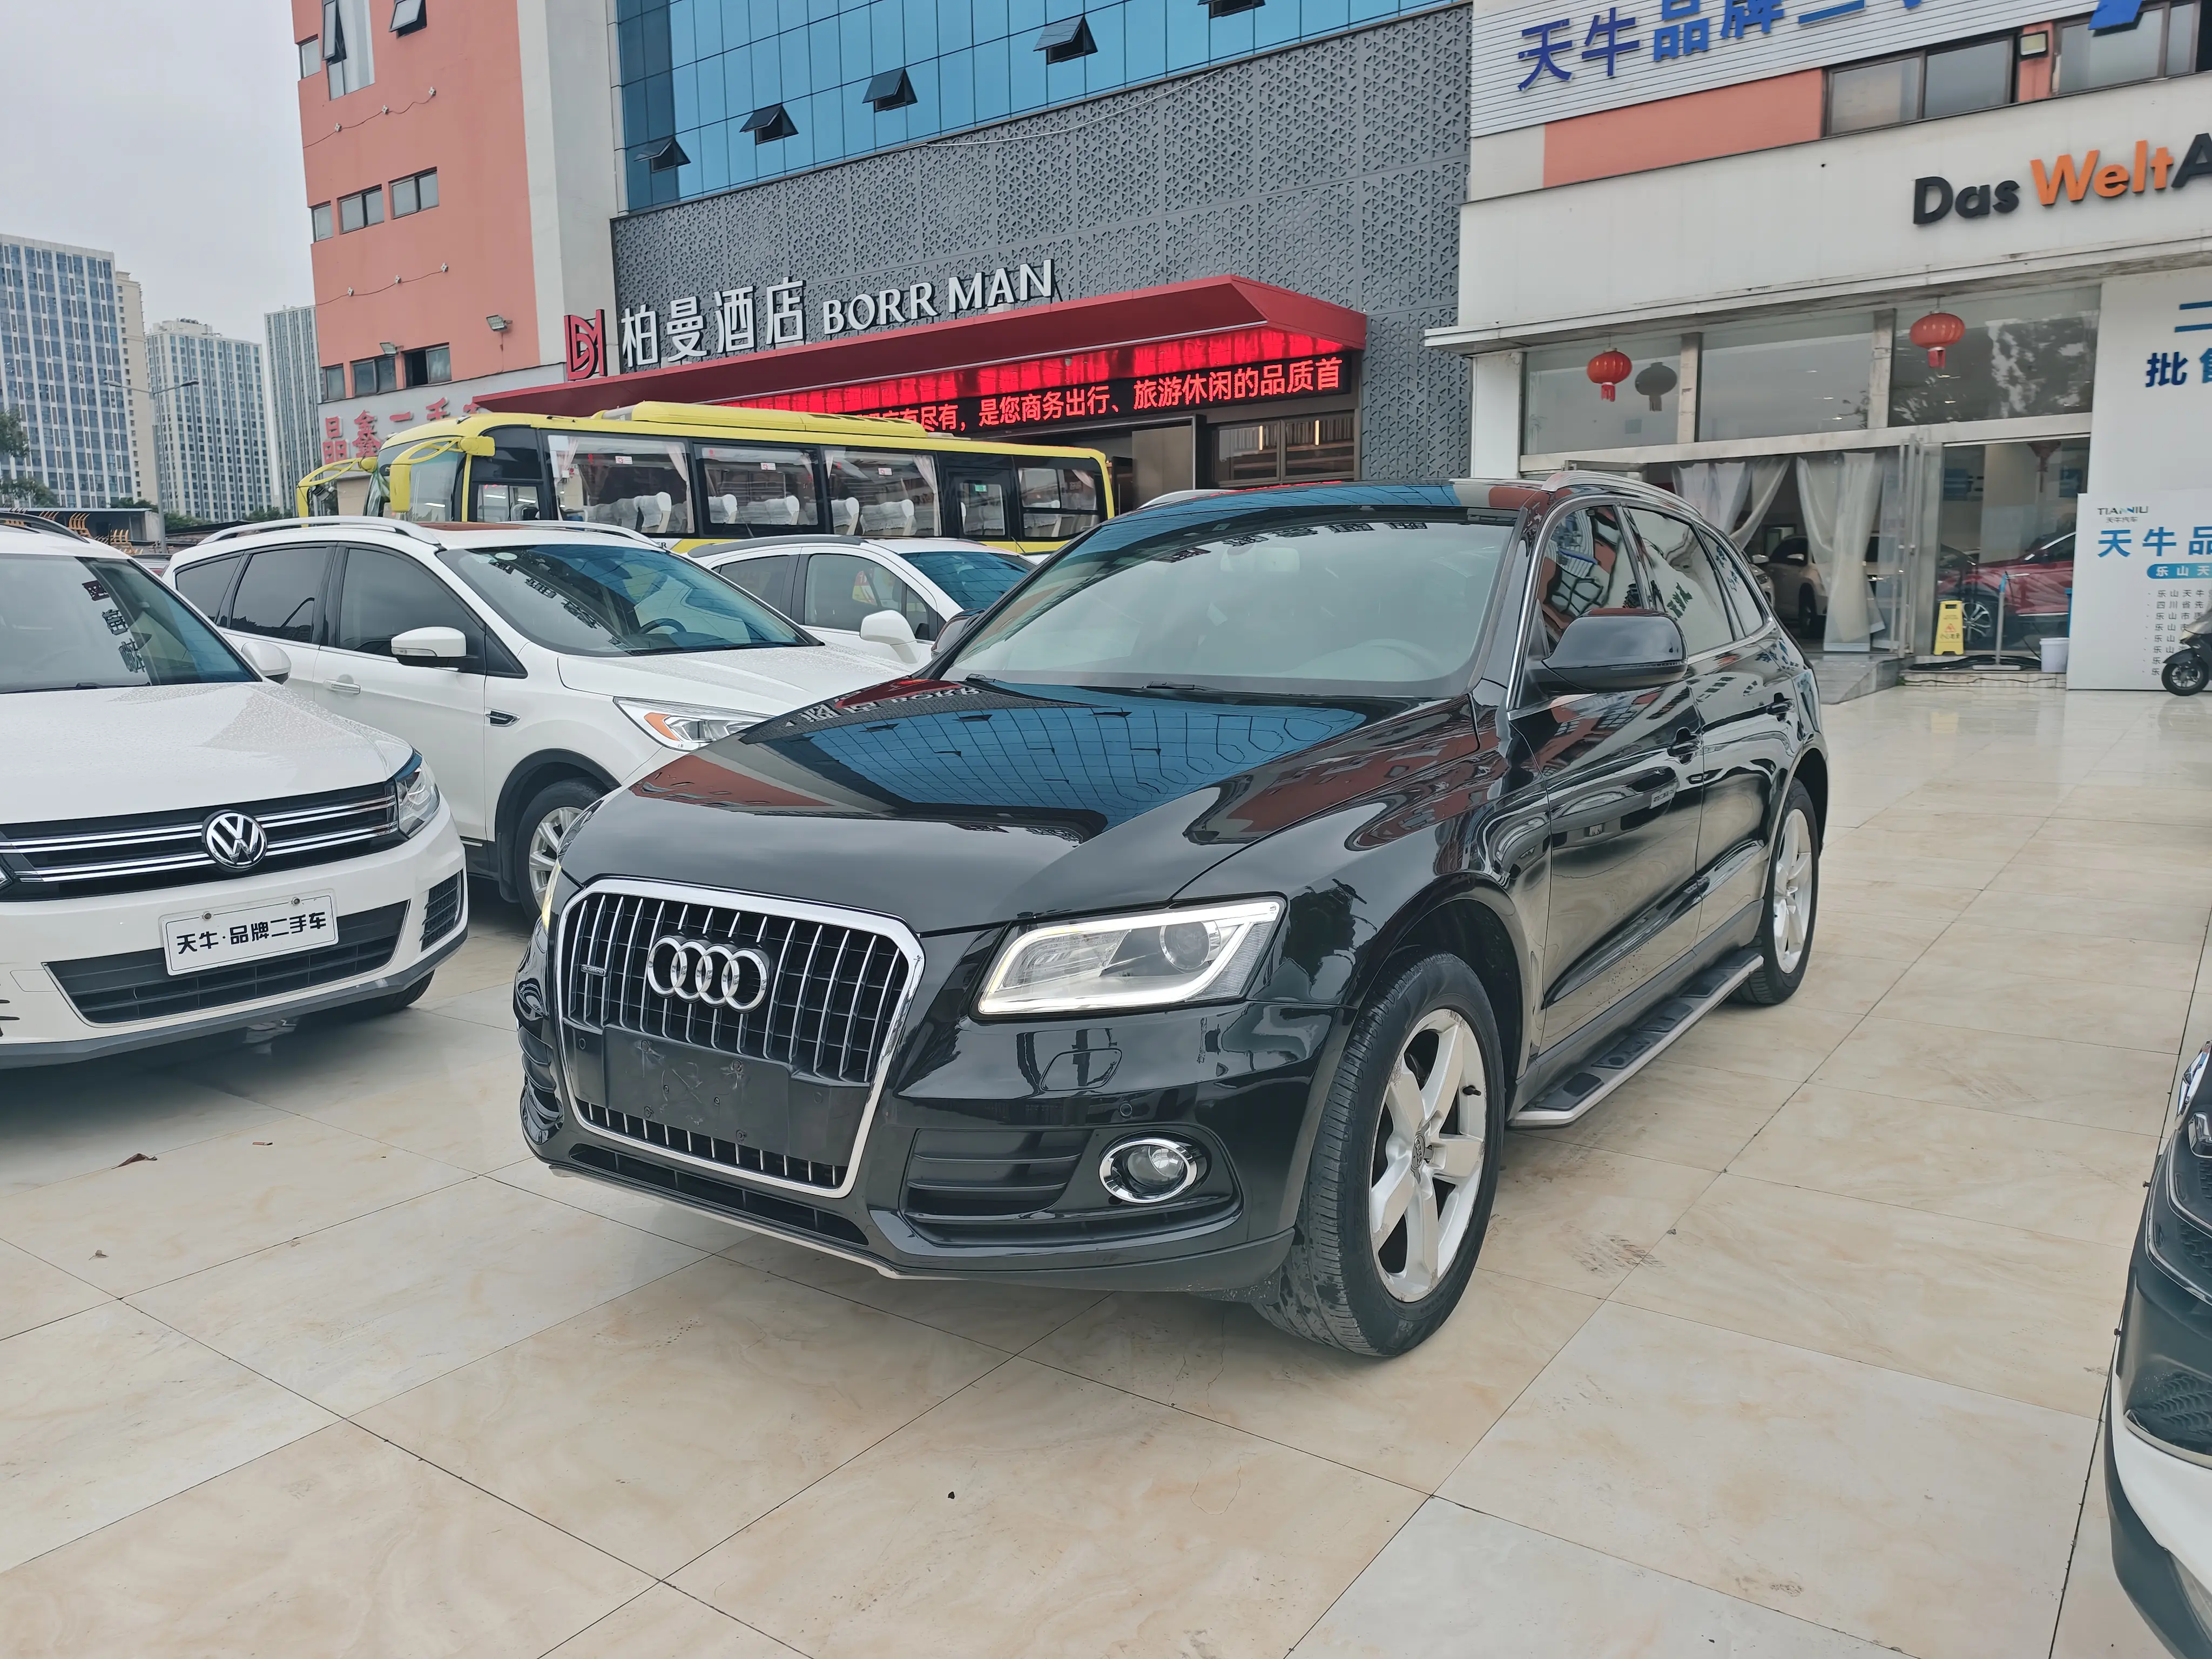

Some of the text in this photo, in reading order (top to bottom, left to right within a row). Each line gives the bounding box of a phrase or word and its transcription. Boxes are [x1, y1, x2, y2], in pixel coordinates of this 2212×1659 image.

[1518, 0, 1921, 92] 天牛品牌
[1913, 176, 2020, 224] Das
[622, 276, 806, 367] 柏曼酒店
[823, 259, 1054, 335] BORR MAN
[856, 356, 1343, 431] 有尽有，是您商务出行、旅游休闲的品质首
[2156, 565, 2210, 576] 乐山天
[2154, 635, 2175, 643] 乐山
[207, 811, 267, 868] VW
[176, 911, 327, 955] 天牛·品牌二手车
